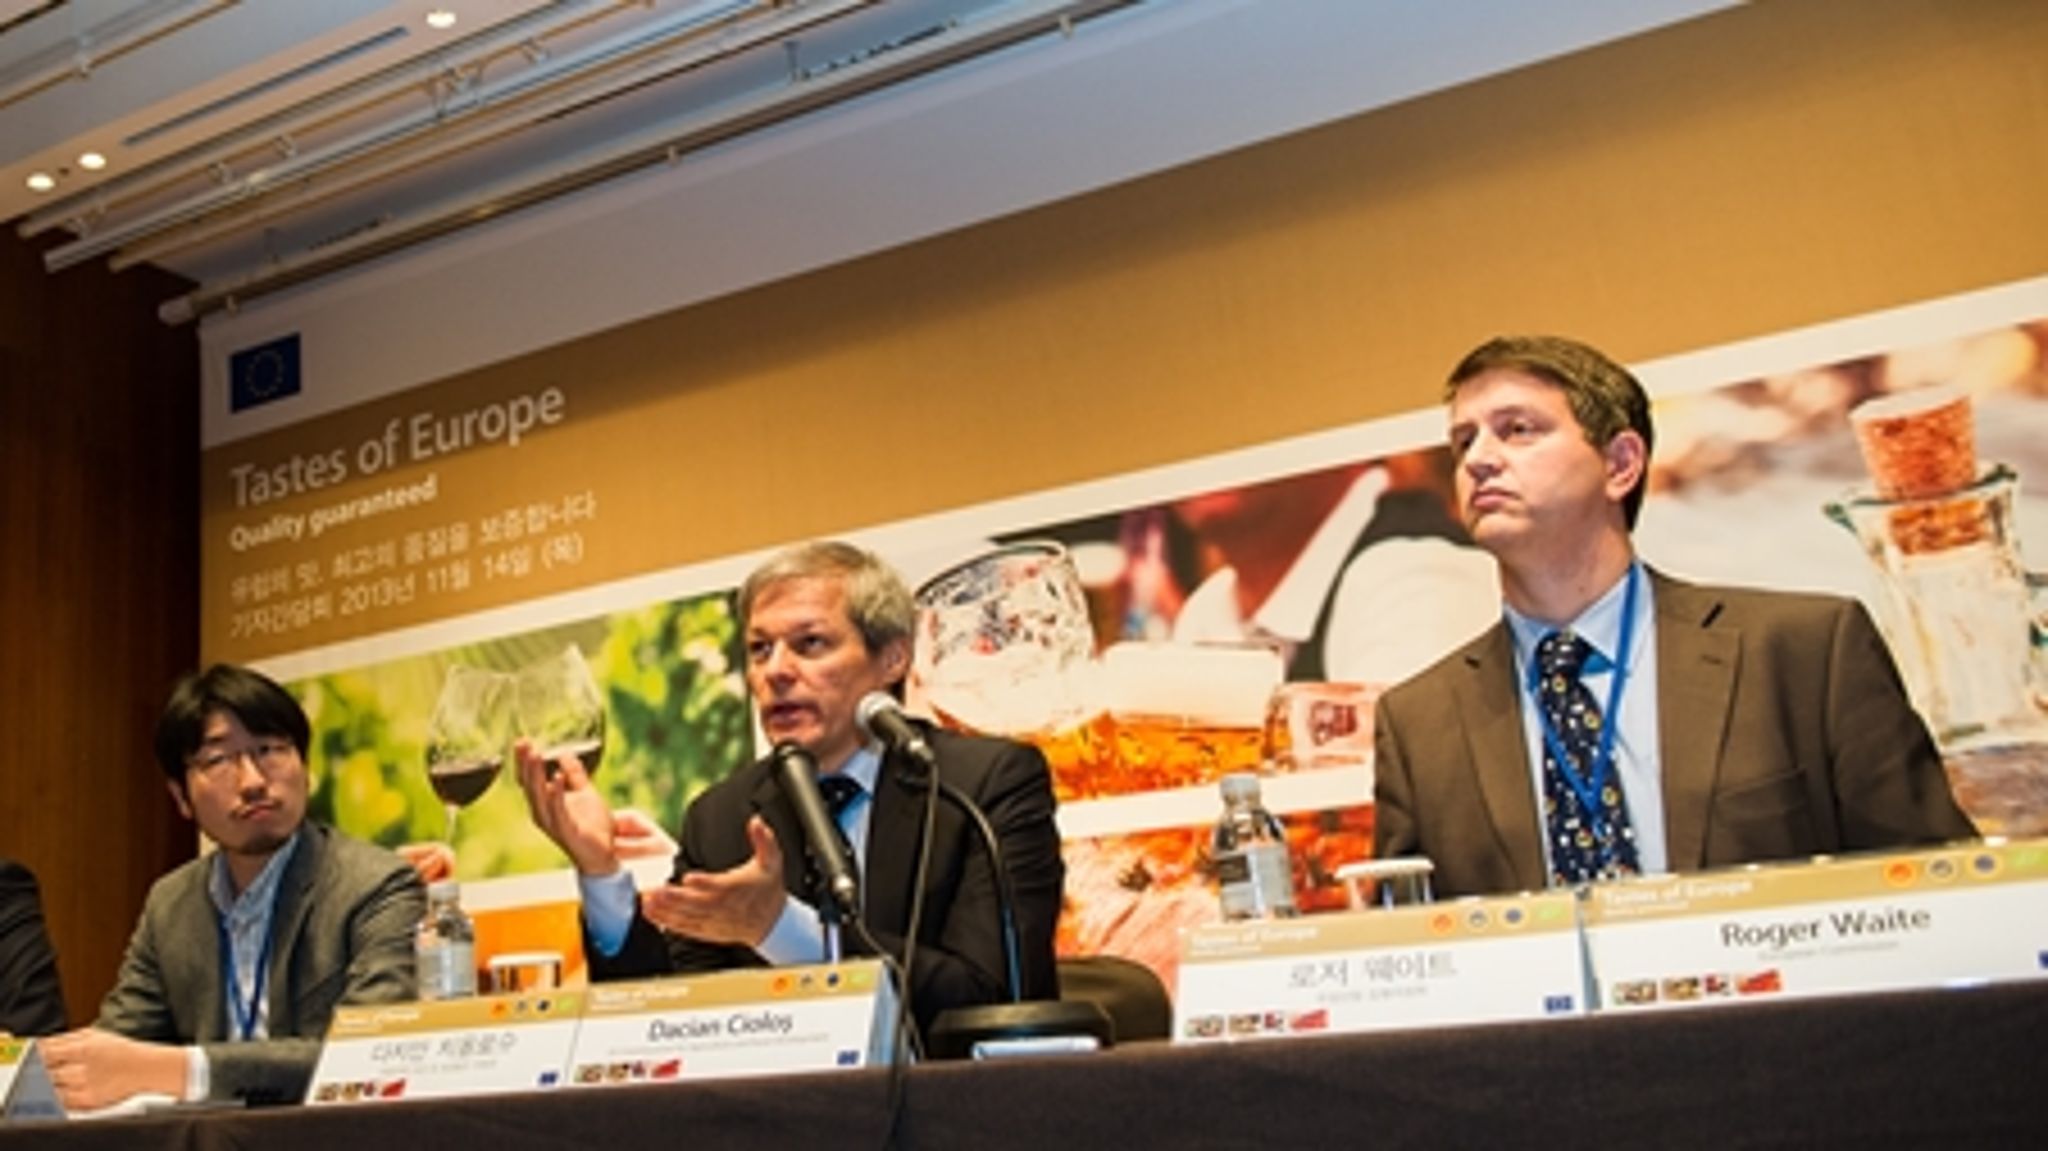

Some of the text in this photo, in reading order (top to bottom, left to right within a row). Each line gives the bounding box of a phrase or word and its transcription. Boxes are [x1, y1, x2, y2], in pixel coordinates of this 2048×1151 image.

[229, 386, 566, 509] Tastes of Europe
[229, 472, 438, 552] Quality guaranteed
[332, 539, 396, 580] 최고의
[403, 520, 470, 566] 품질을
[479, 489, 598, 546] 보증합니다
[340, 570, 416, 617] 2013년
[426, 558, 471, 594] 11월
[481, 544, 534, 581] 14일
[1720, 906, 1933, 950] Roger Waite
[649, 1018, 720, 1040] Dacian
